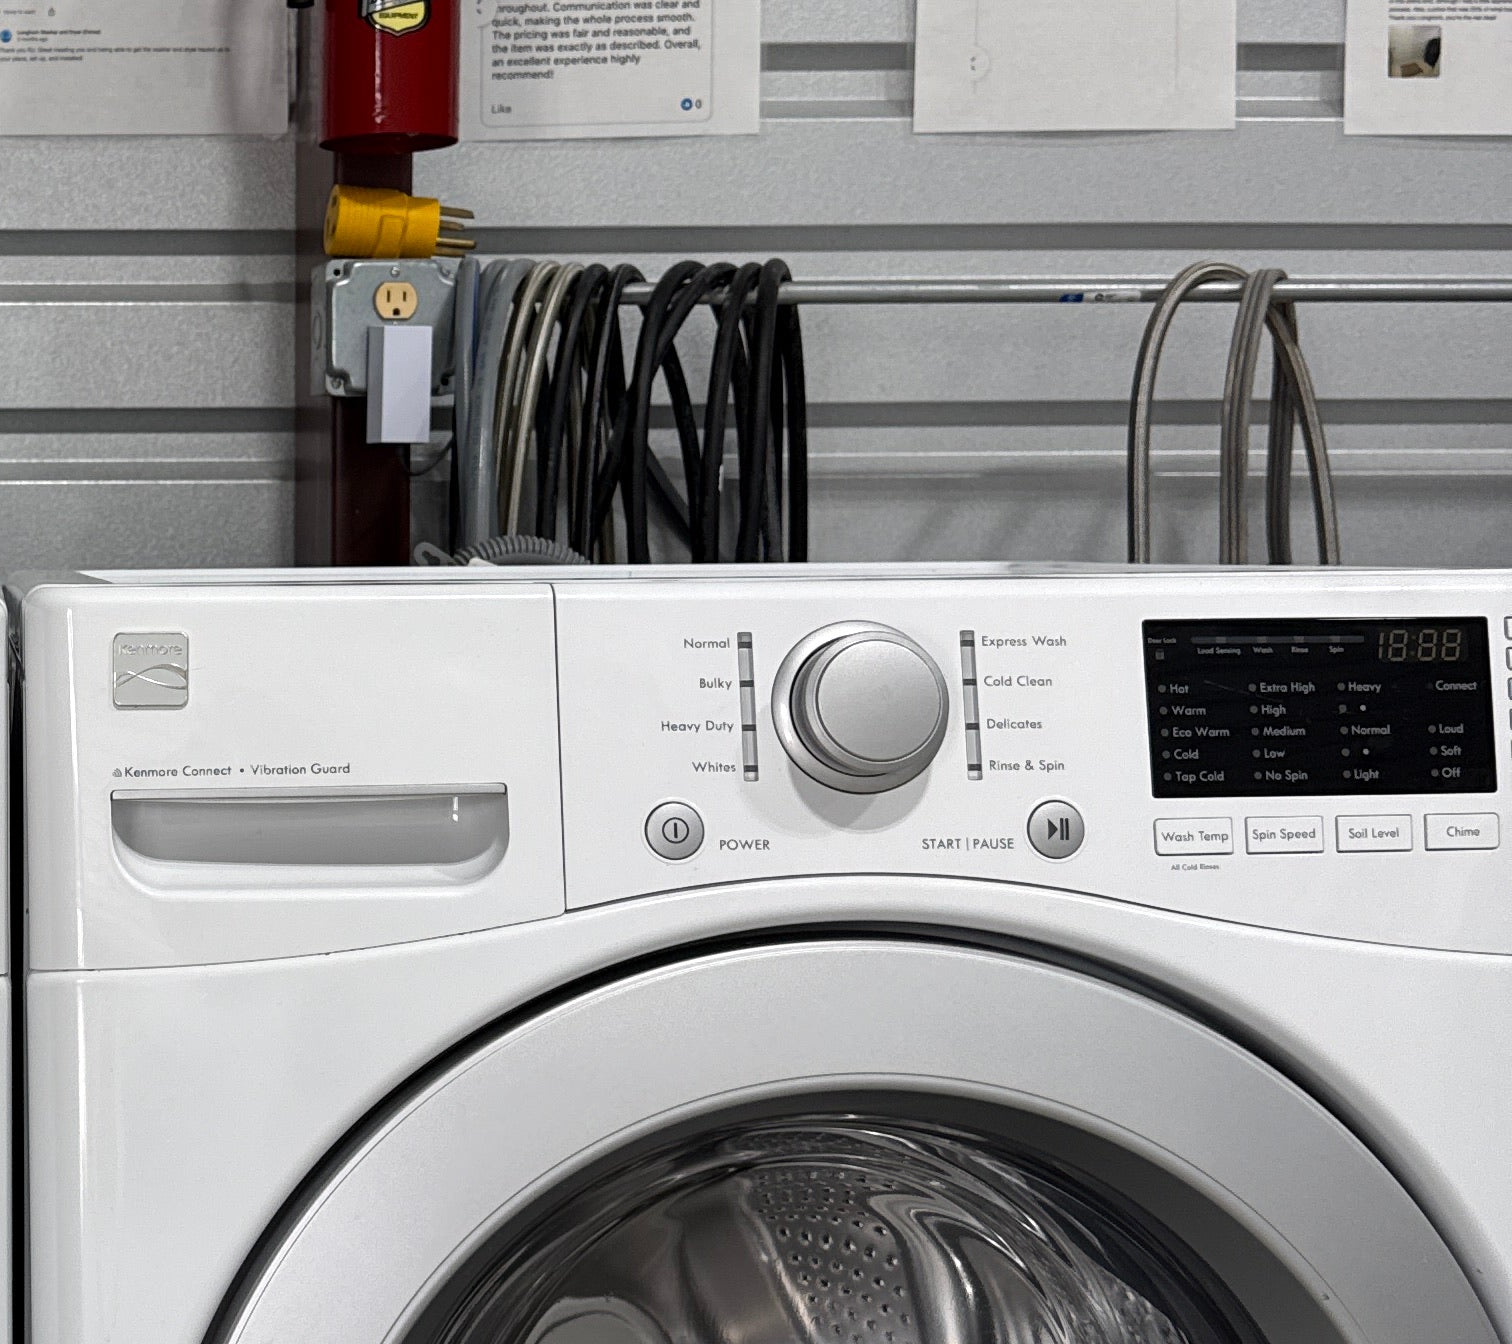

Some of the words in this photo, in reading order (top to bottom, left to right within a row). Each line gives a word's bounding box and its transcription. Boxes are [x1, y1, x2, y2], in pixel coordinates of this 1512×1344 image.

[683, 637, 730, 649] Normal
[981, 635, 1027, 649] Express
[1031, 635, 1066, 646] Wash
[699, 677, 732, 691] Bulky
[983, 675, 1012, 687] Cold
[1016, 675, 1052, 687] Clean
[1348, 681, 1381, 693] Heavy
[1435, 680, 1478, 691] Connect
[1169, 683, 1188, 694] Hot
[1259, 682, 1288, 692] Extra
[1290, 681, 1315, 694] High
[1171, 705, 1206, 716] Warm
[1260, 703, 1286, 717] High
[660, 720, 700, 733] Heavy
[705, 720, 734, 733] Duty
[986, 717, 1042, 730] Delicates
[1350, 723, 1390, 735] Normal
[1439, 723, 1465, 735] Loud
[1172, 726, 1192, 737] Eco
[1194, 726, 1230, 737] Warm
[1262, 725, 1306, 736] Medium
[1173, 748, 1199, 760] Cold
[1264, 747, 1285, 759] Low
[1440, 744, 1462, 756] Soft
[125, 766, 178, 778] Kenmore
[182, 764, 232, 776] Connect
[250, 763, 306, 775] Vibration
[310, 762, 350, 775] Guard
[691, 761, 736, 772] Whites
[989, 759, 1020, 771] Rinse
[1024, 759, 1034, 771] &
[1038, 759, 1064, 773] Spin
[1441, 766, 1460, 778] Off
[1175, 770, 1196, 784] Tap
[1198, 770, 1224, 782] Cold
[1265, 770, 1282, 780] No
[1284, 769, 1308, 782] Spin
[1353, 767, 1379, 782] Light
[1160, 830, 1194, 842] Wash
[1198, 831, 1229, 844] Temp
[1252, 828, 1276, 842] Spin
[1279, 827, 1316, 842] Speed
[1348, 827, 1368, 839] Soil
[1371, 827, 1399, 839] Level
[1446, 825, 1480, 837] Chime
[719, 838, 770, 851] POWER
[921, 838, 961, 850] START
[972, 837, 1014, 850] PAUSE
